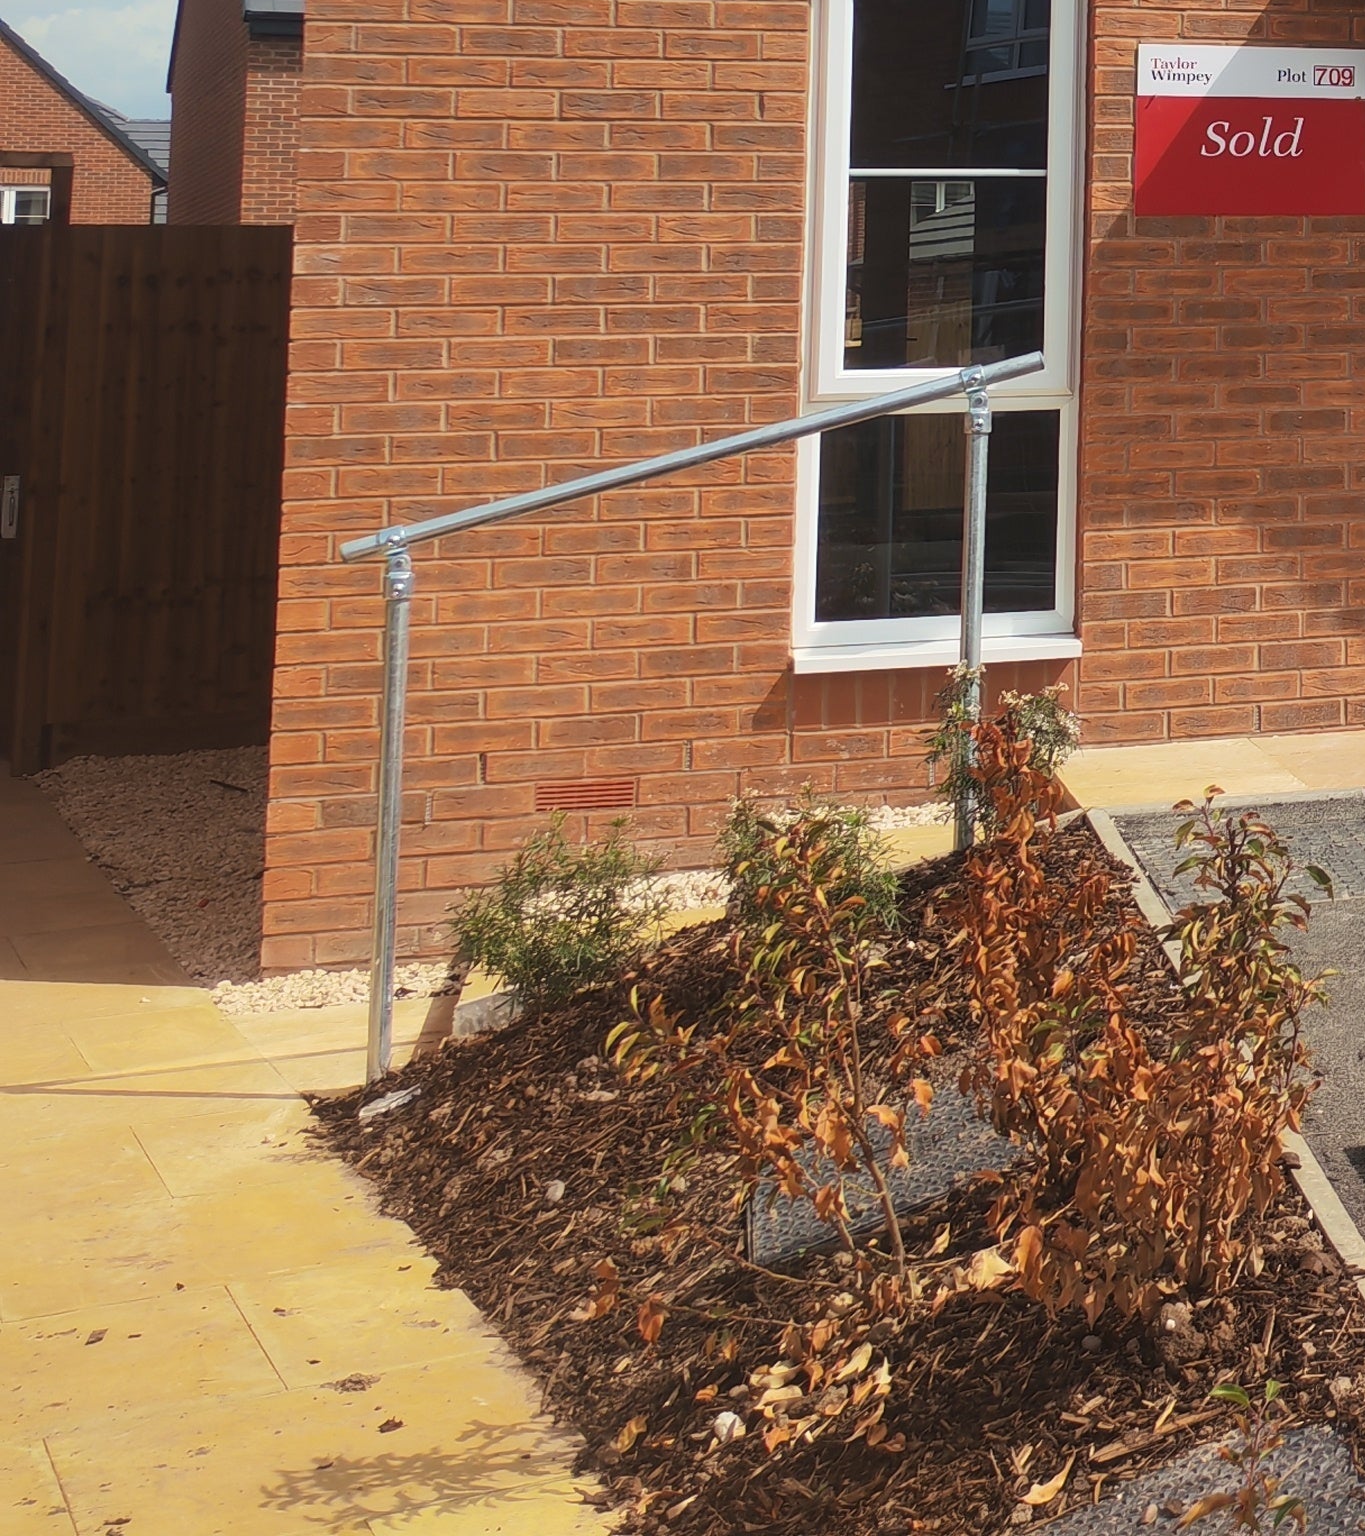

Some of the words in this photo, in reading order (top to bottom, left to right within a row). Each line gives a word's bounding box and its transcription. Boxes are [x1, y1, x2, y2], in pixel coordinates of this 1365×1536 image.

[1150, 57, 1198, 71] Taylor
[1151, 69, 1213, 85] Wimpey
[1277, 68, 1307, 83] Plot
[1315, 68, 1353, 86] 709
[1200, 116, 1305, 158] Sold
